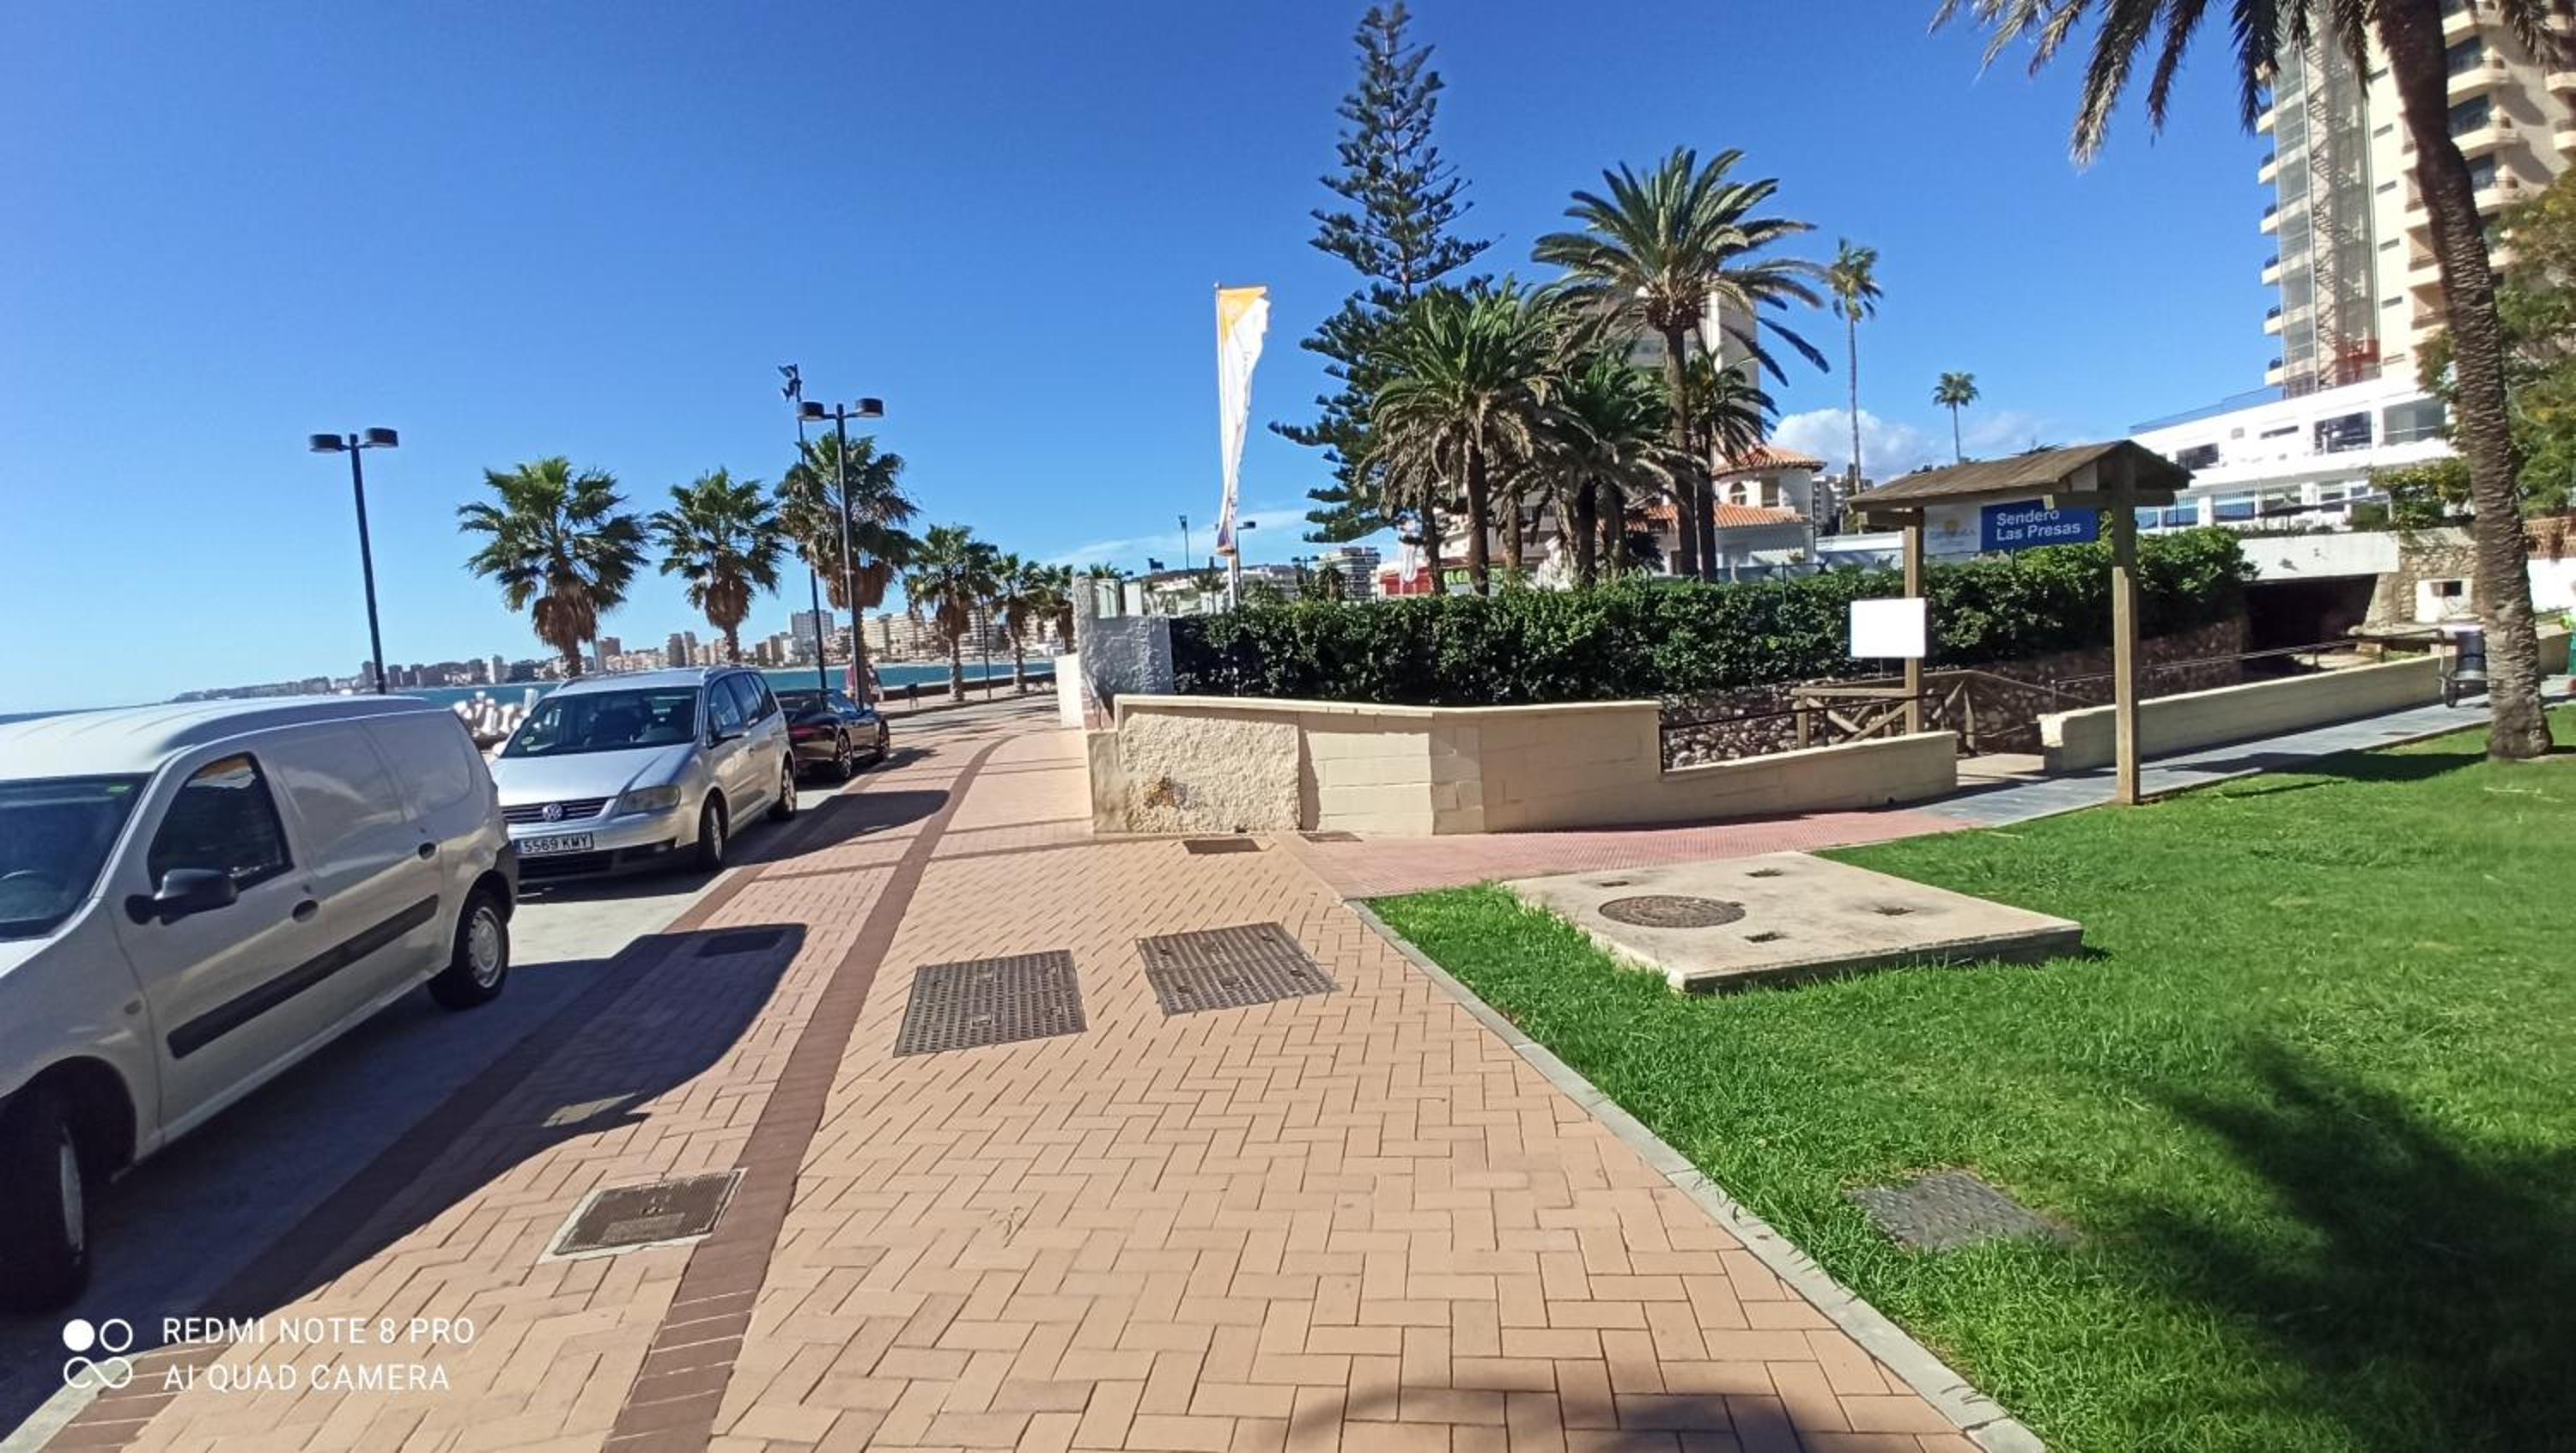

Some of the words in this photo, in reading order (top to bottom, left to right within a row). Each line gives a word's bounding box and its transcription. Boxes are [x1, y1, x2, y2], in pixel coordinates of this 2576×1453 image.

[1996, 509, 2060, 526] Sendero
[1996, 528, 2022, 541] Las
[2027, 523, 2081, 539] Presas
